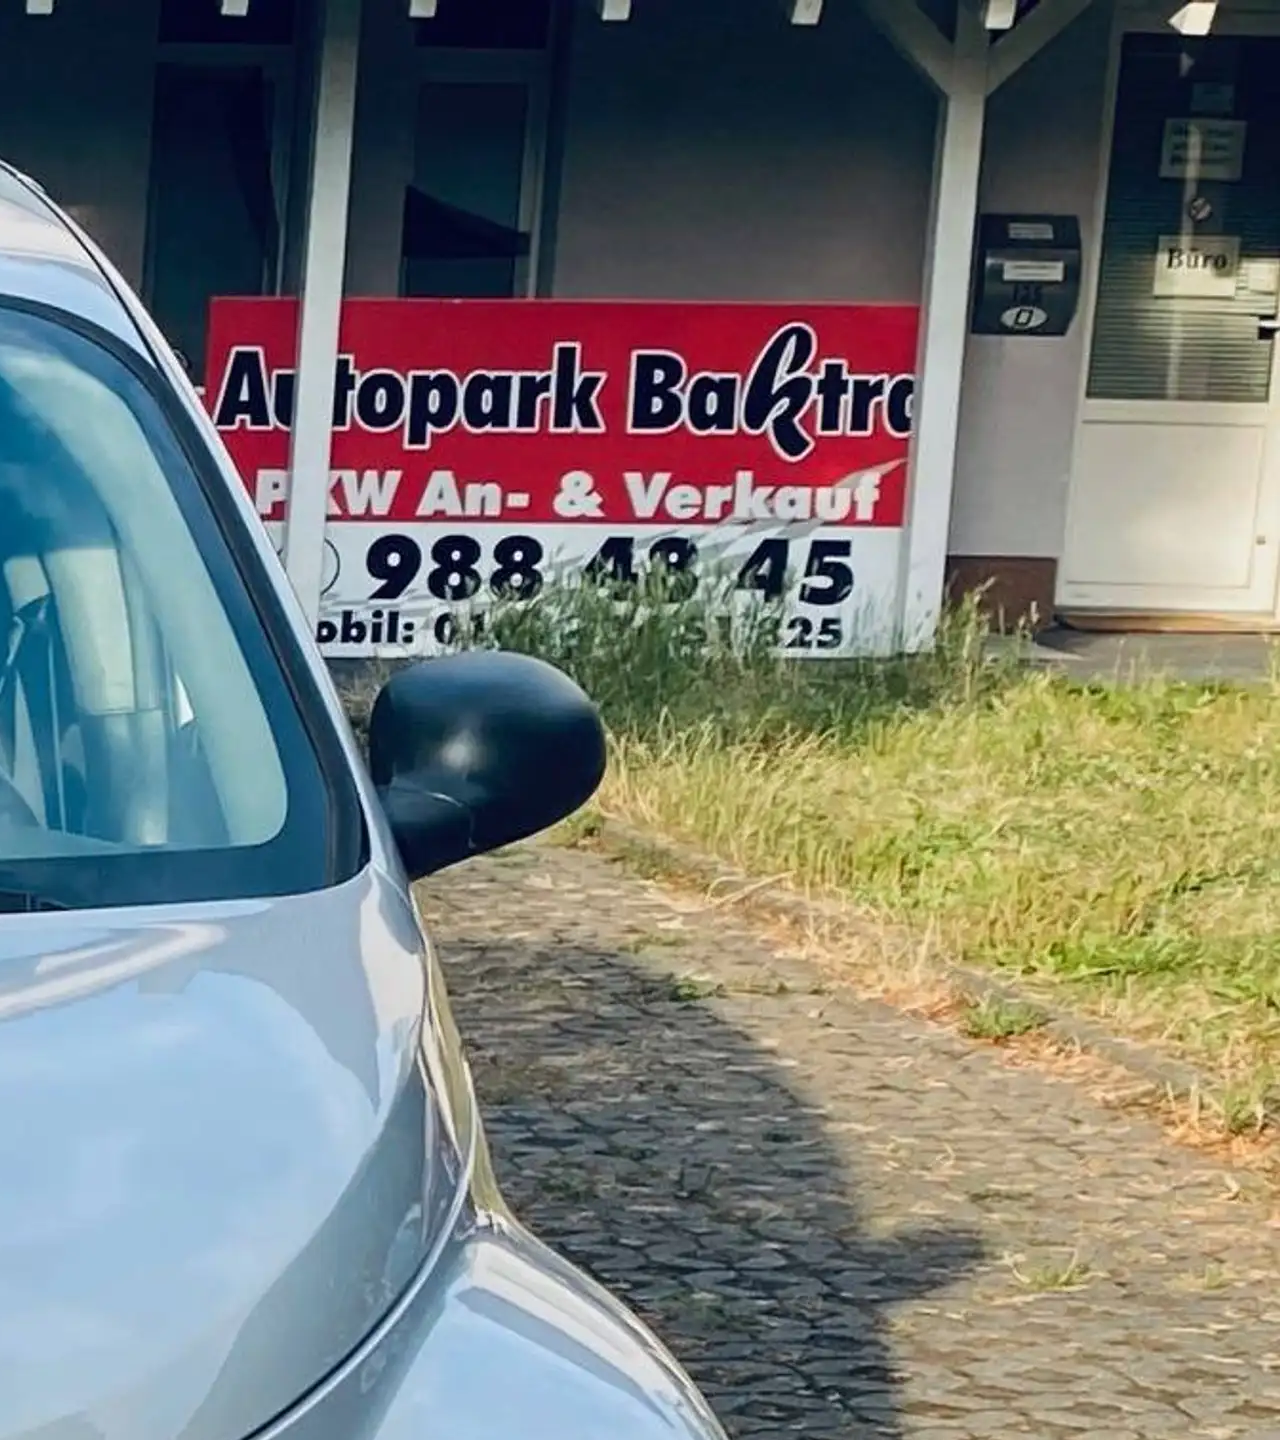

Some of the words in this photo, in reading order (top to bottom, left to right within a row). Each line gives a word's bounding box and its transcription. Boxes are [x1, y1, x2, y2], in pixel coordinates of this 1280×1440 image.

[415, 470, 530, 517] An-
[553, 470, 606, 518] &
[623, 470, 880, 522] Verkauf
[366, 533, 544, 601] 988
[737, 537, 854, 606] 45
[315, 610, 414, 645] obil:
